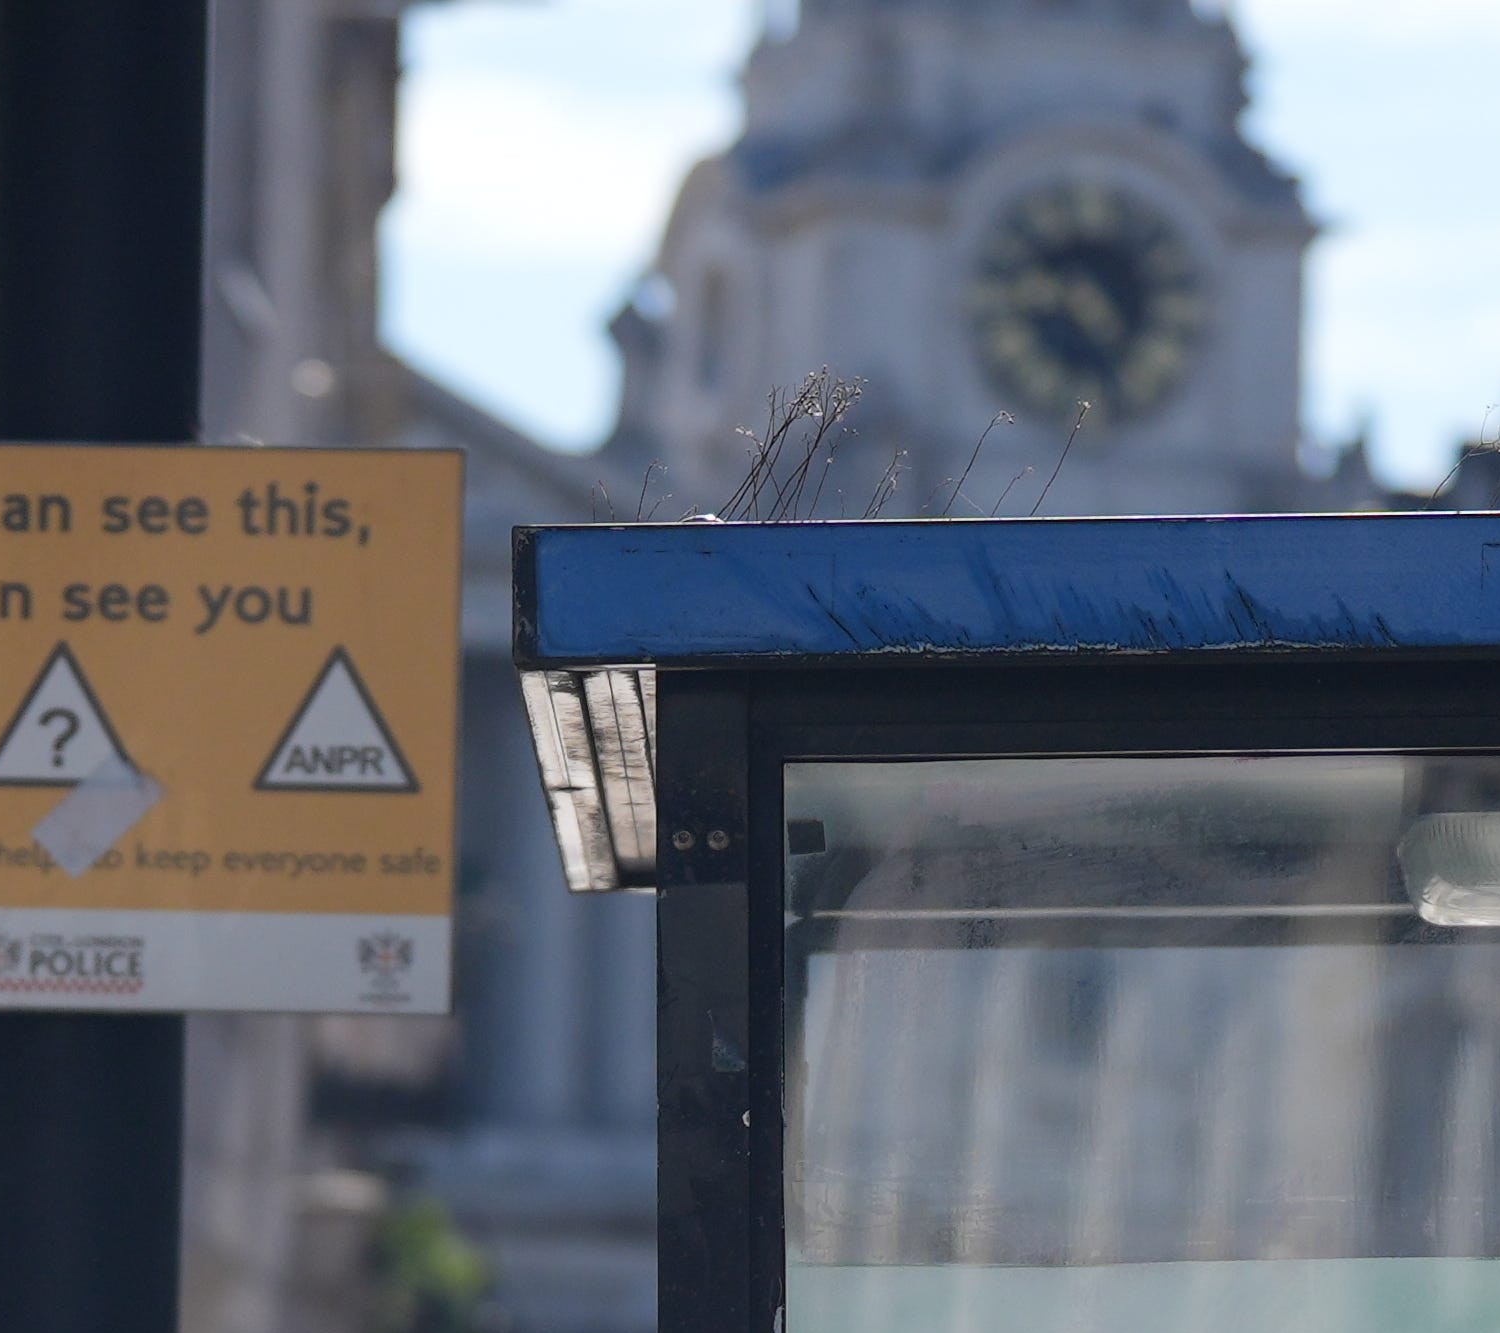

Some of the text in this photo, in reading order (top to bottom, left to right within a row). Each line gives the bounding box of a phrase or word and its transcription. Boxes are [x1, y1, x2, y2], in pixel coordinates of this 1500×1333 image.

[99, 494, 211, 536] see
[236, 480, 371, 546] this,
[60, 581, 171, 623] see
[193, 583, 314, 636] you
[38, 706, 82, 768] ?
[284, 745, 385, 777] ANPR
[133, 841, 212, 878] keep
[221, 849, 369, 878] everyone
[377, 846, 443, 877] safe
[29, 949, 142, 977] POLICE
